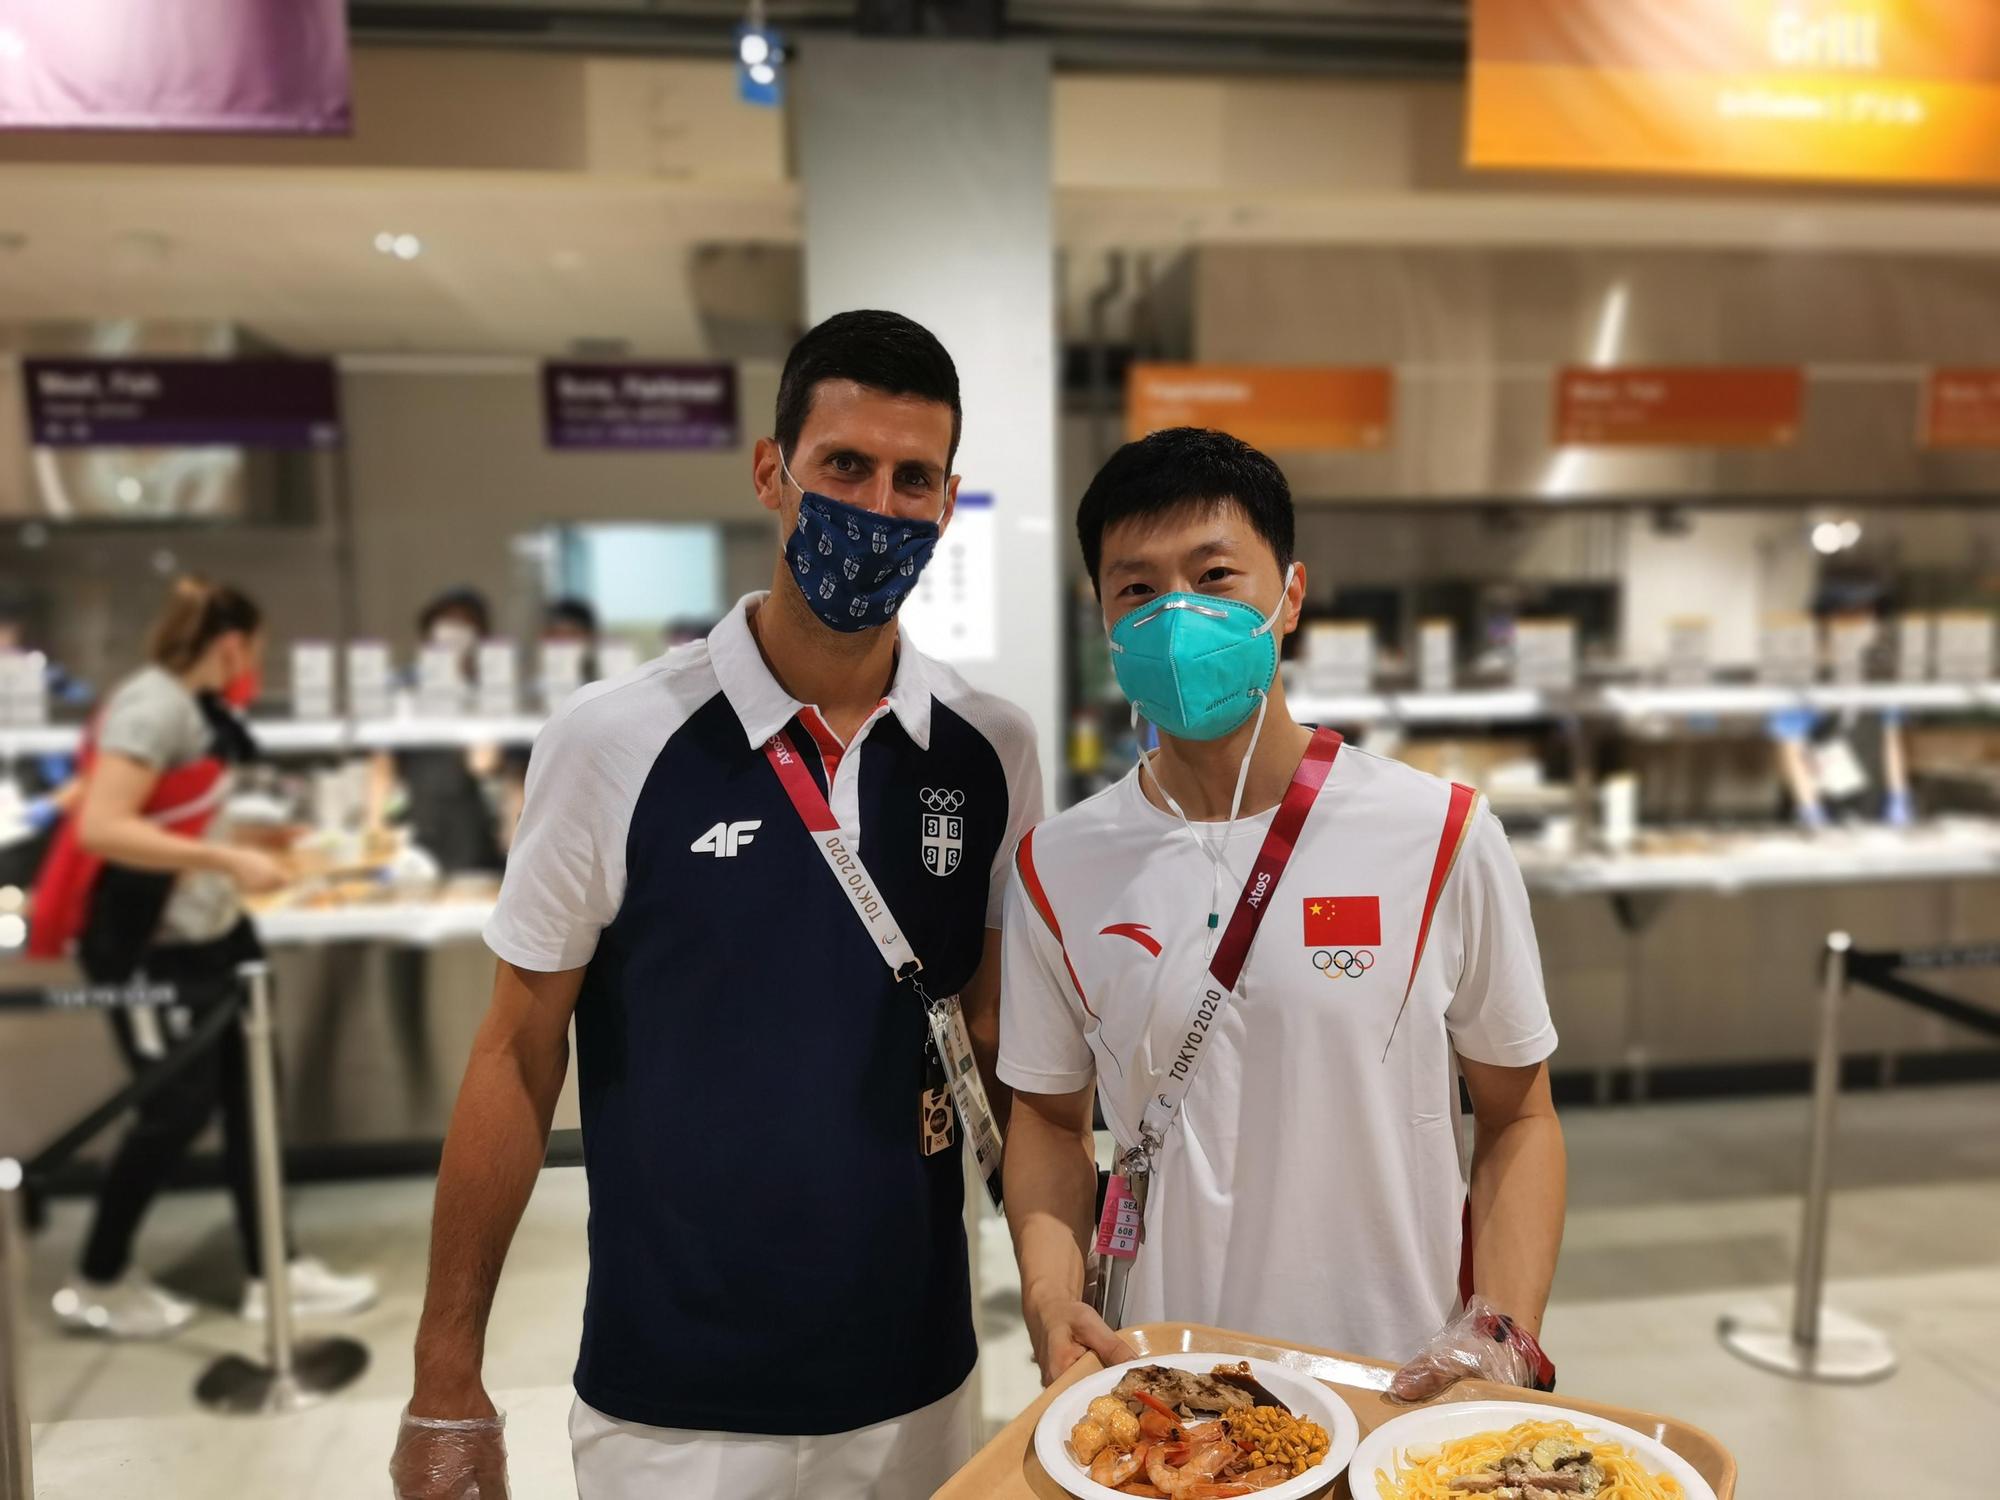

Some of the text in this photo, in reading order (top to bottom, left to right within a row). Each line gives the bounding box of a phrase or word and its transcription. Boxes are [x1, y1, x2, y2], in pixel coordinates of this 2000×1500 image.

[690, 819, 763, 858] 4F
[825, 837, 882, 923] TOKYO 2020
[1246, 871, 1271, 910] Atos
[1168, 989, 1222, 1082] TOKYO 2020
[1117, 1226, 1134, 1237] 608
[1125, 1214, 1131, 1223] 5
